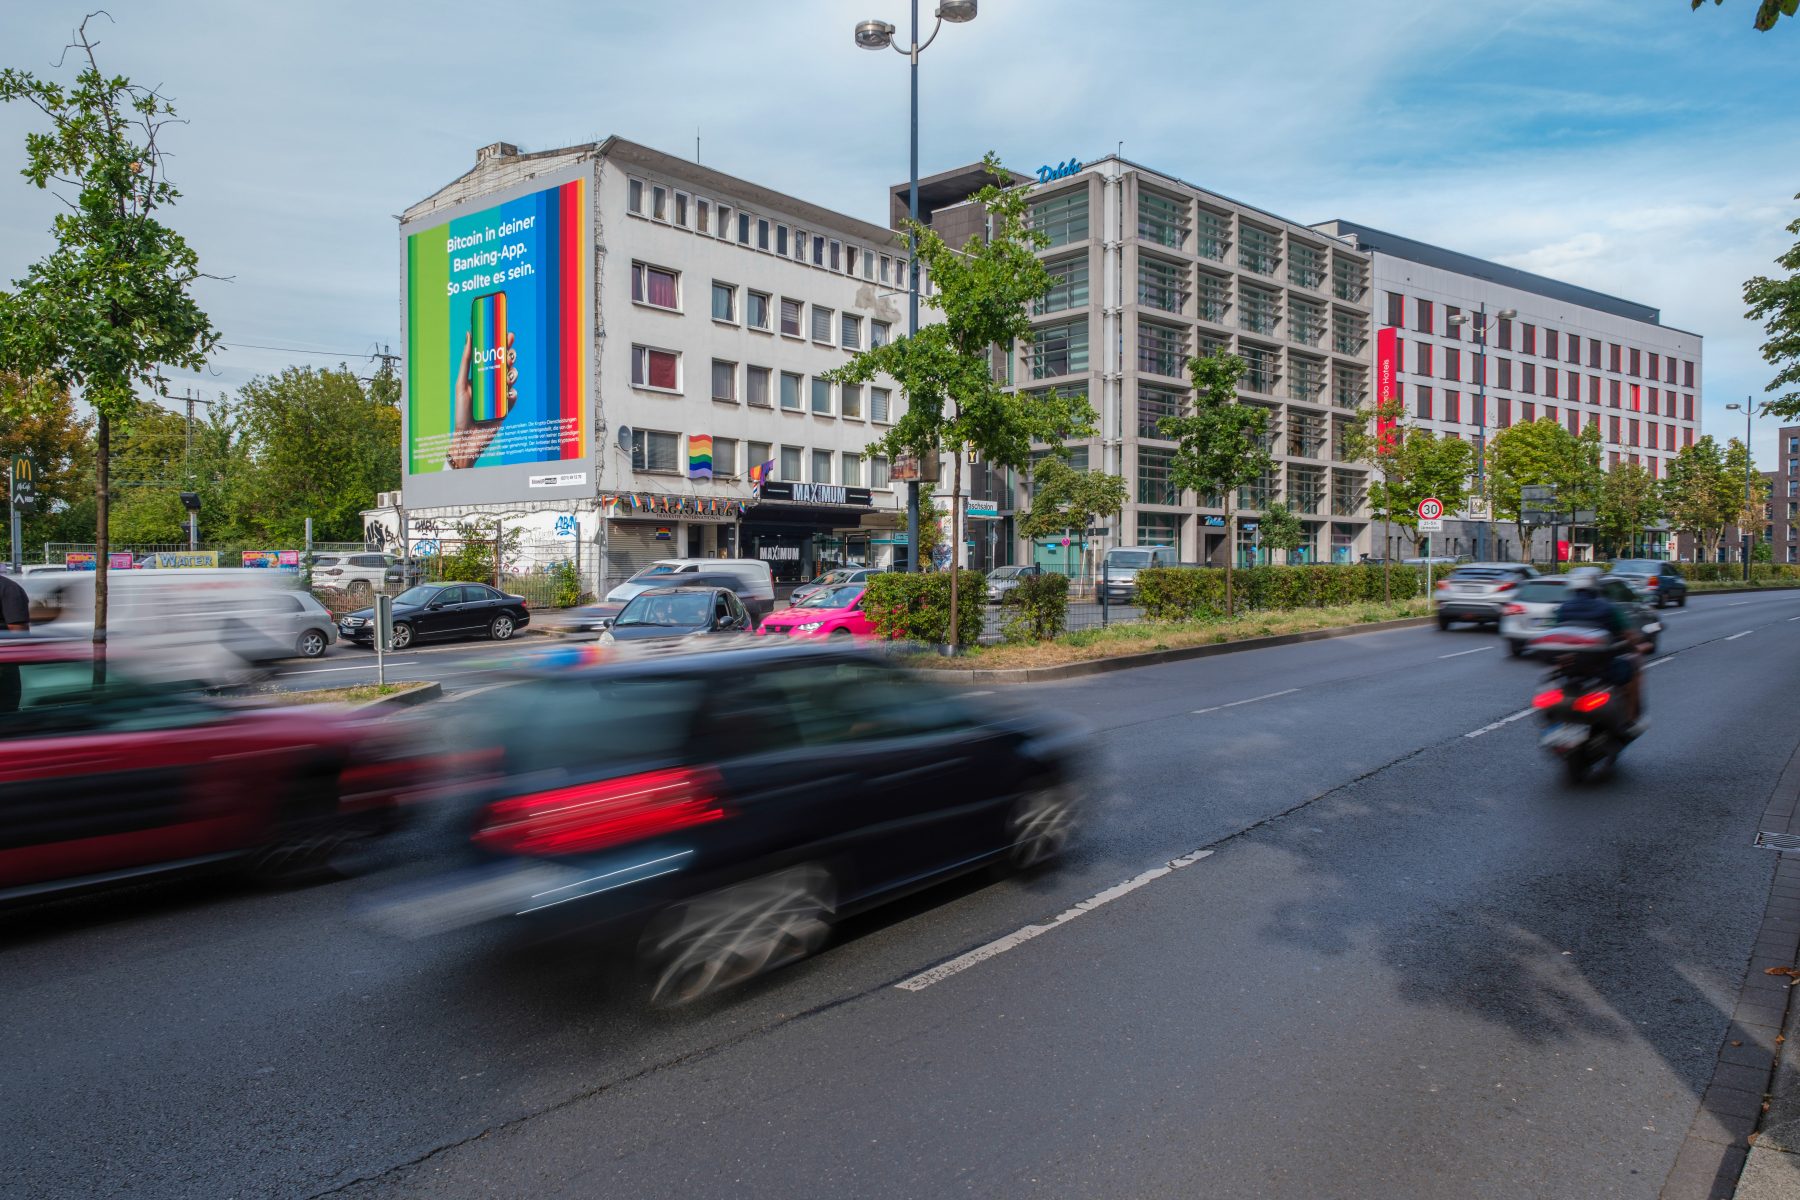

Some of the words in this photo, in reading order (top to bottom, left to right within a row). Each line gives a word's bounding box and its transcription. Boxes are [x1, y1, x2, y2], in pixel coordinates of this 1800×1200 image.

[447, 232, 483, 253] Bitcoin
[486, 226, 496, 241] in
[499, 215, 535, 238] deiner
[453, 243, 527, 272] Banking-App.
[447, 281, 460, 296] So
[462, 274, 491, 291] sollte
[493, 272, 505, 284] es
[508, 261, 535, 280] sein.
[474, 347, 505, 364] bunq
[793, 482, 846, 504] MAXIMUM
[1423, 504, 1438, 515] 30
[160, 553, 213, 567] WATER
[759, 545, 799, 560] MAXIMUM
